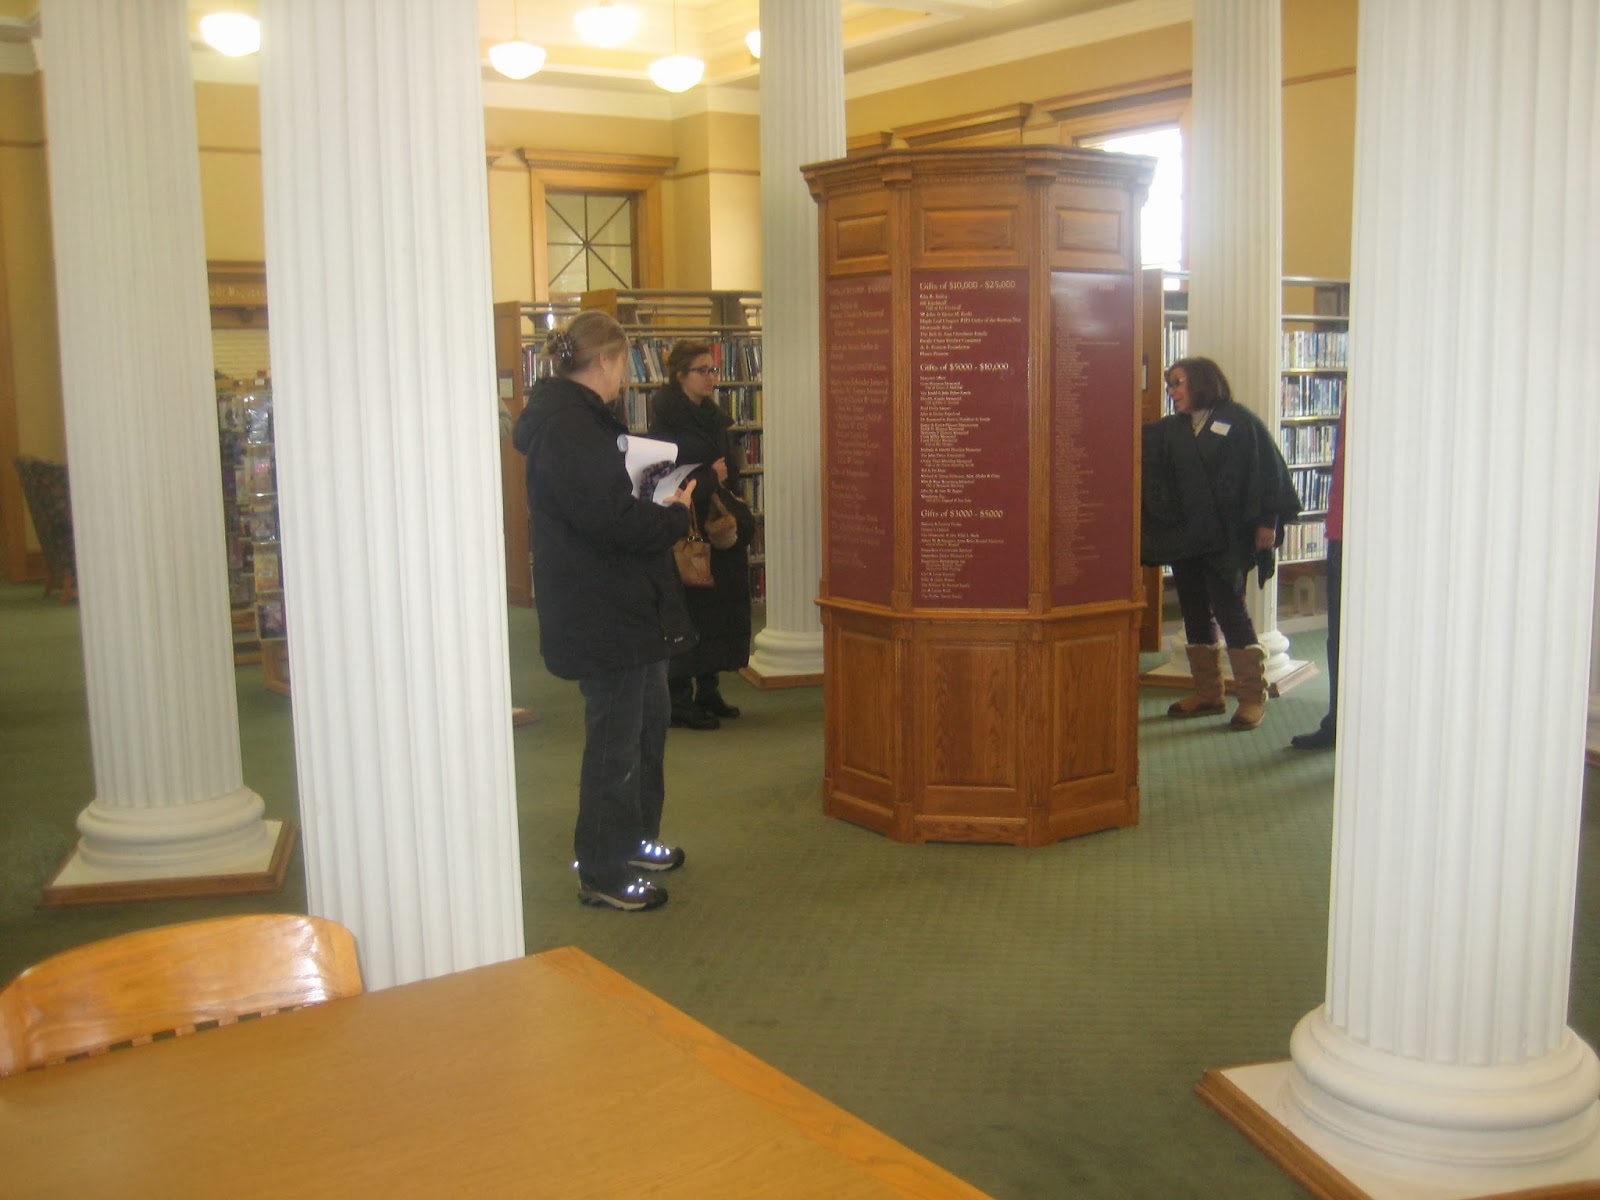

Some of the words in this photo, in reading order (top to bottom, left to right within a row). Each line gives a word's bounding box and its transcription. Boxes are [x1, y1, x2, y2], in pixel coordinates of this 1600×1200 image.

[919, 281, 938, 290] Gifts
[939, 281, 947, 290] of
[949, 281, 978, 290] $10,000
[984, 280, 1016, 290] $25,000
[919, 363, 938, 371] Gifts
[939, 363, 948, 371] of
[949, 363, 973, 372] $5000
[979, 363, 1009, 372] $10,000
[920, 509, 939, 518] Gifts
[940, 509, 949, 518] of
[949, 509, 973, 518] $3000
[979, 509, 1004, 518] $5000
